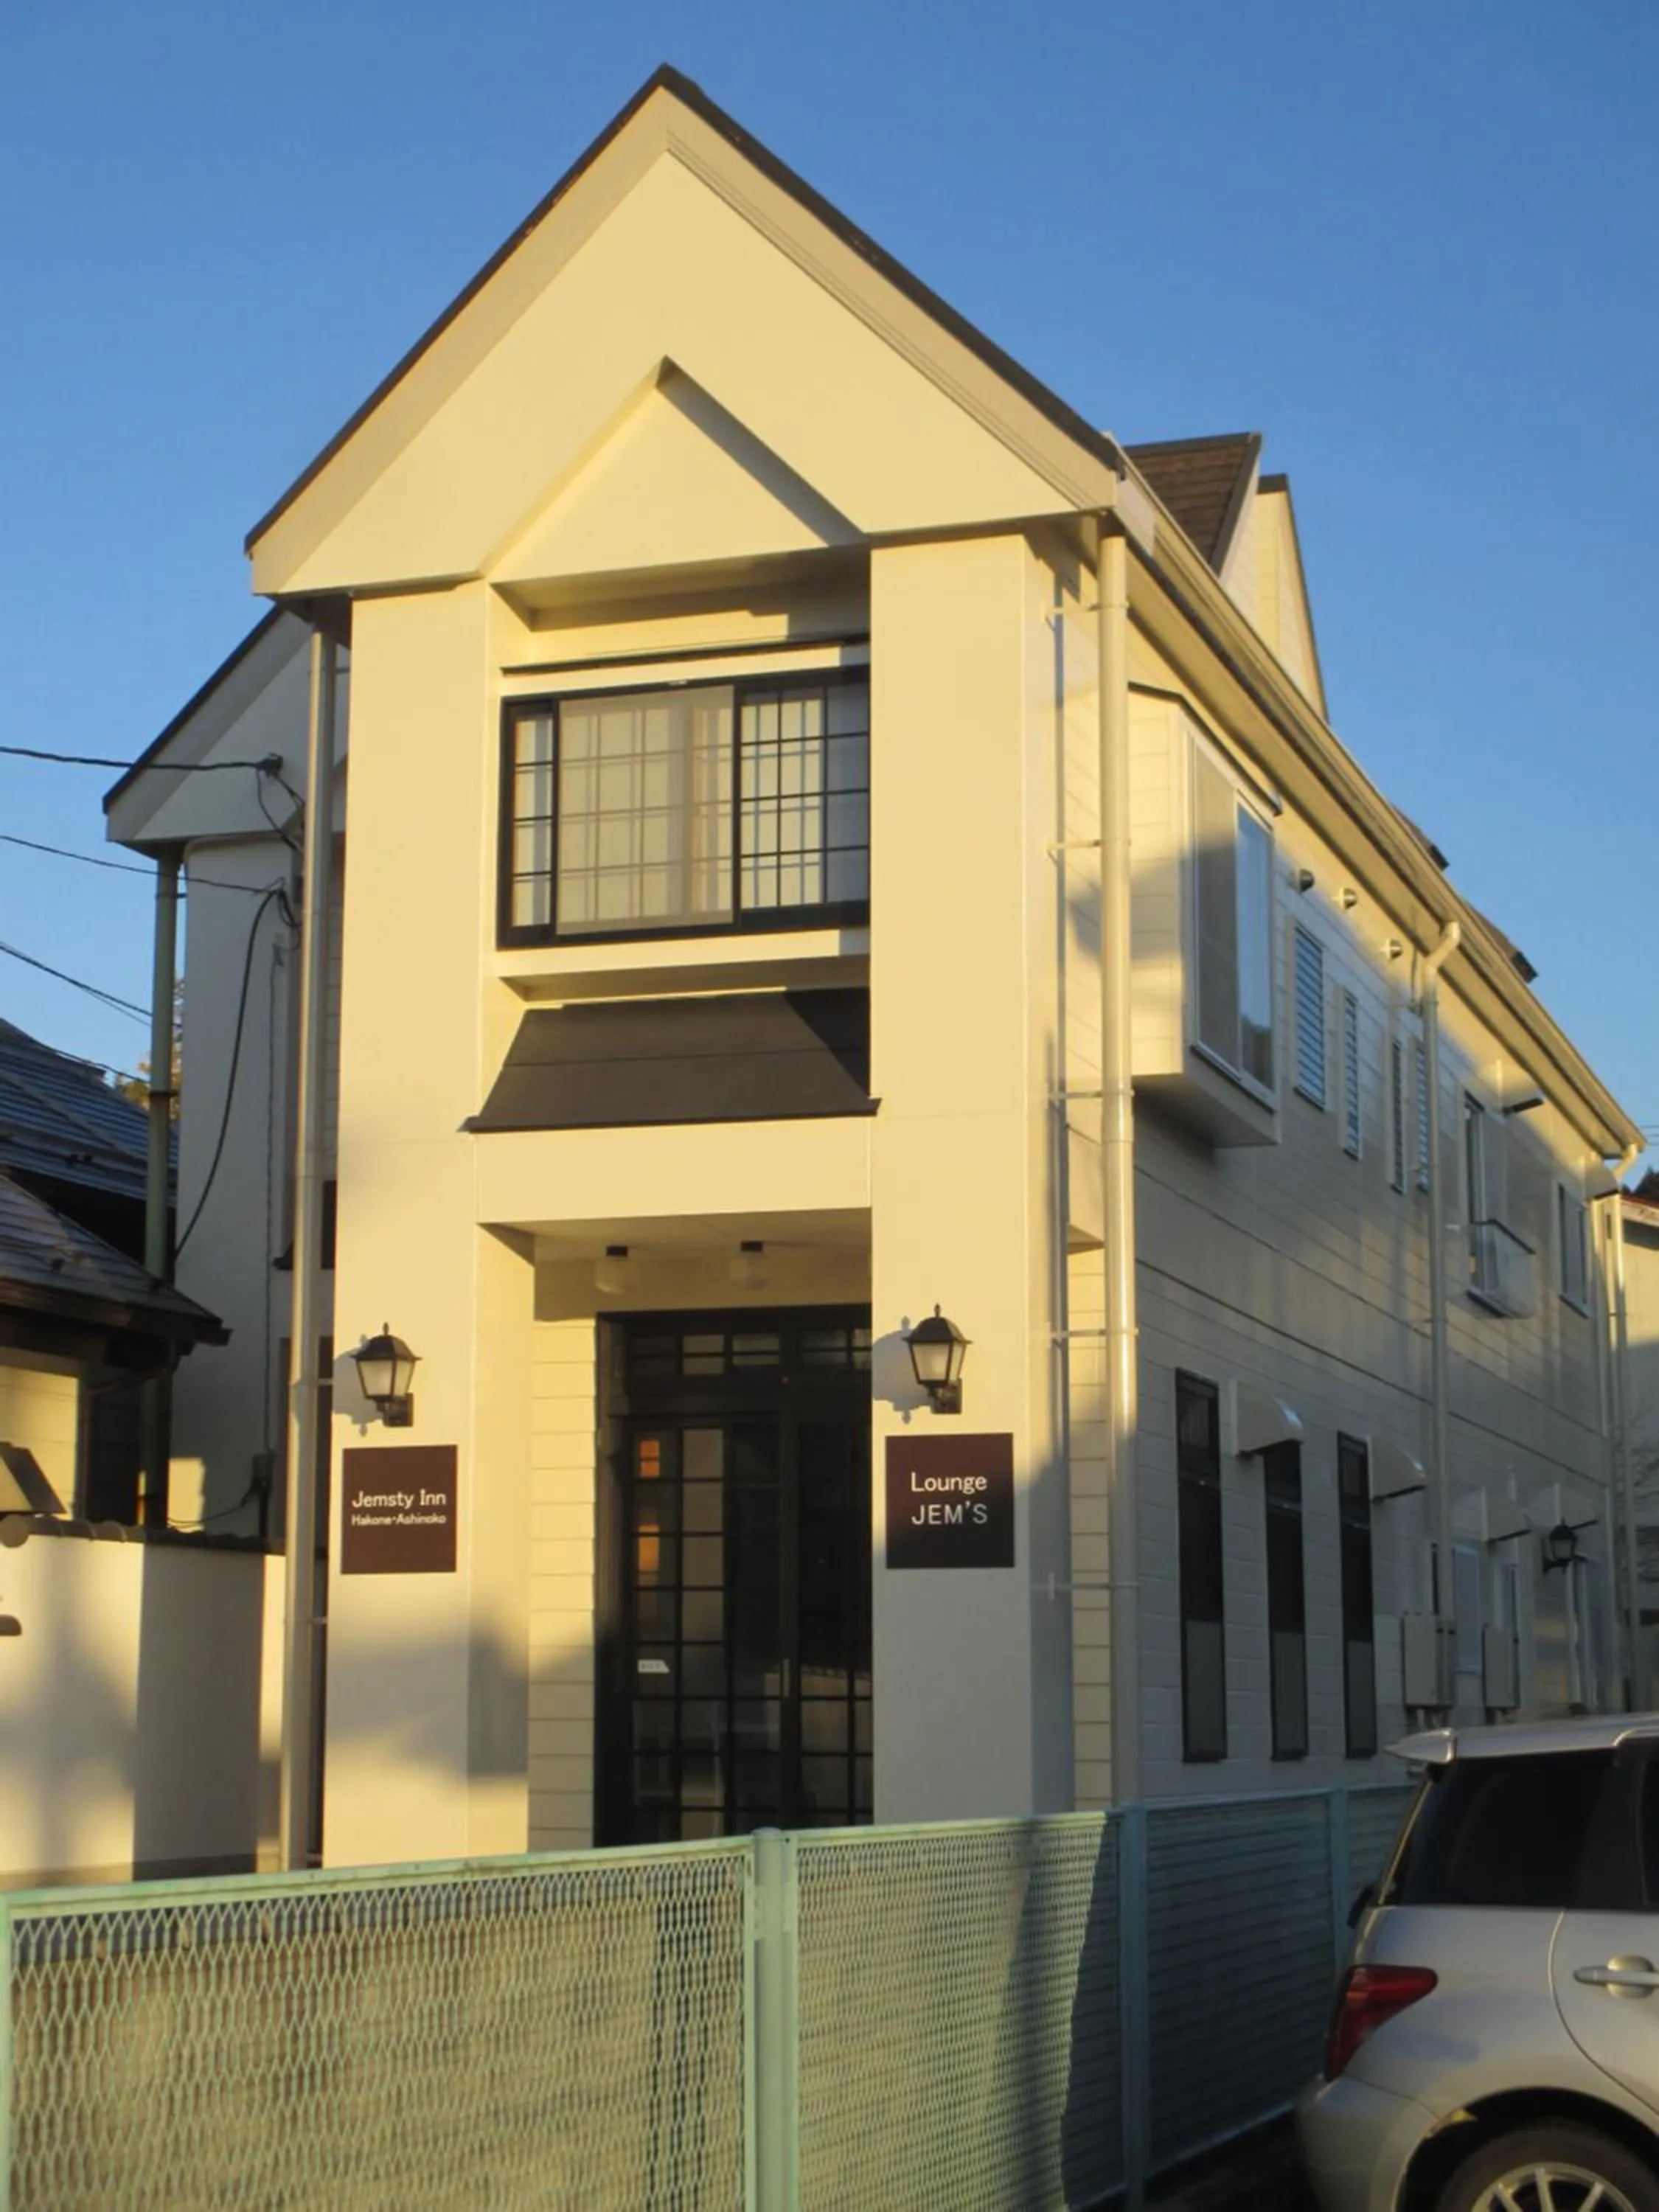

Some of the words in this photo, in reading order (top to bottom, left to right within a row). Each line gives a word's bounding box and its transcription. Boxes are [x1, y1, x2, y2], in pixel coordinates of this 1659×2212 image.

[911, 1471, 987, 1495] Lounge
[352, 1490, 414, 1509] Jemsty
[420, 1489, 447, 1506] Inn
[911, 1500, 988, 1526] JEM'S
